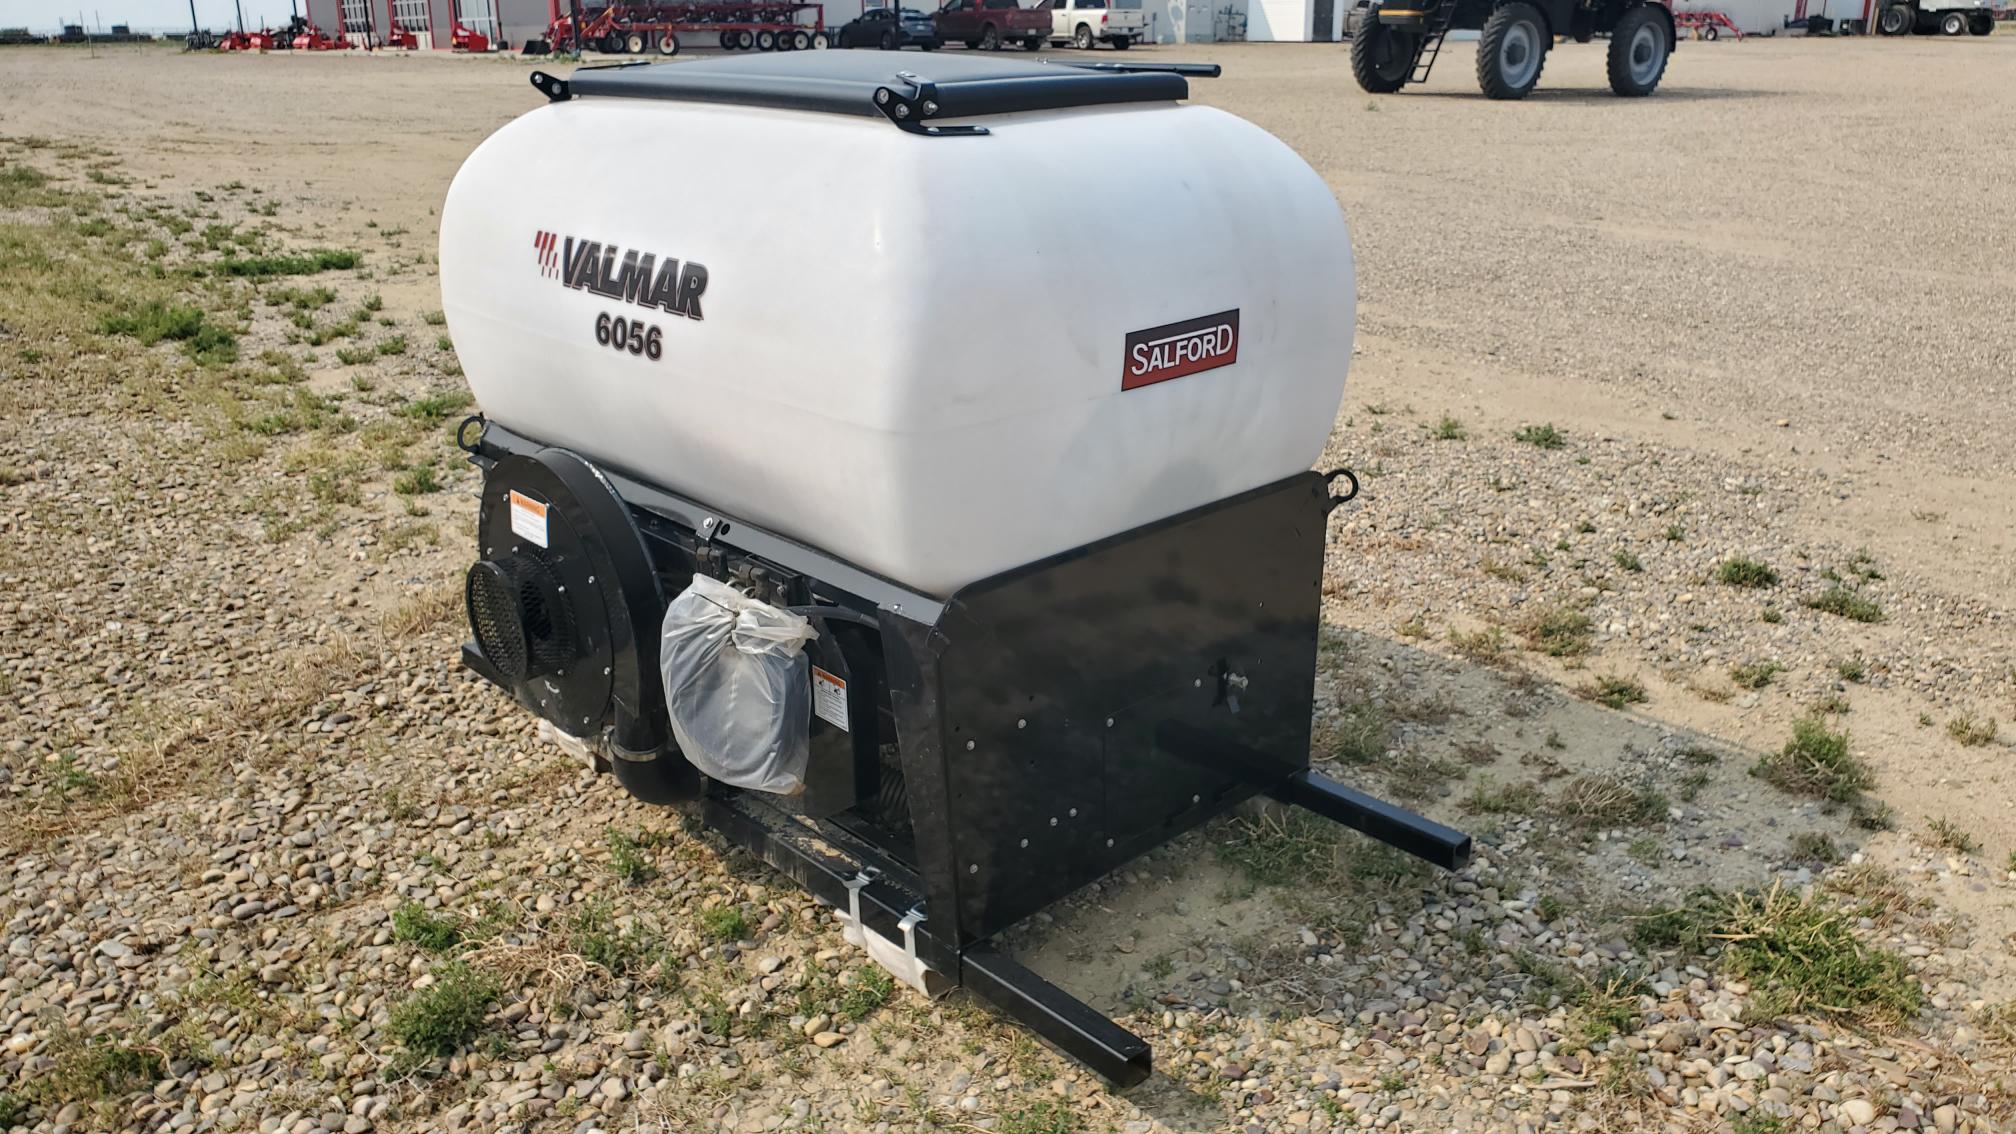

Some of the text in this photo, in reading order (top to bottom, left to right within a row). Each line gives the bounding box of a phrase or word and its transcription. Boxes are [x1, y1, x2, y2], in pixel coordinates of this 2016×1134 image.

[562, 236, 709, 321] VALMAR
[595, 311, 664, 361] 6056
[1131, 324, 1233, 376] SALFORD
